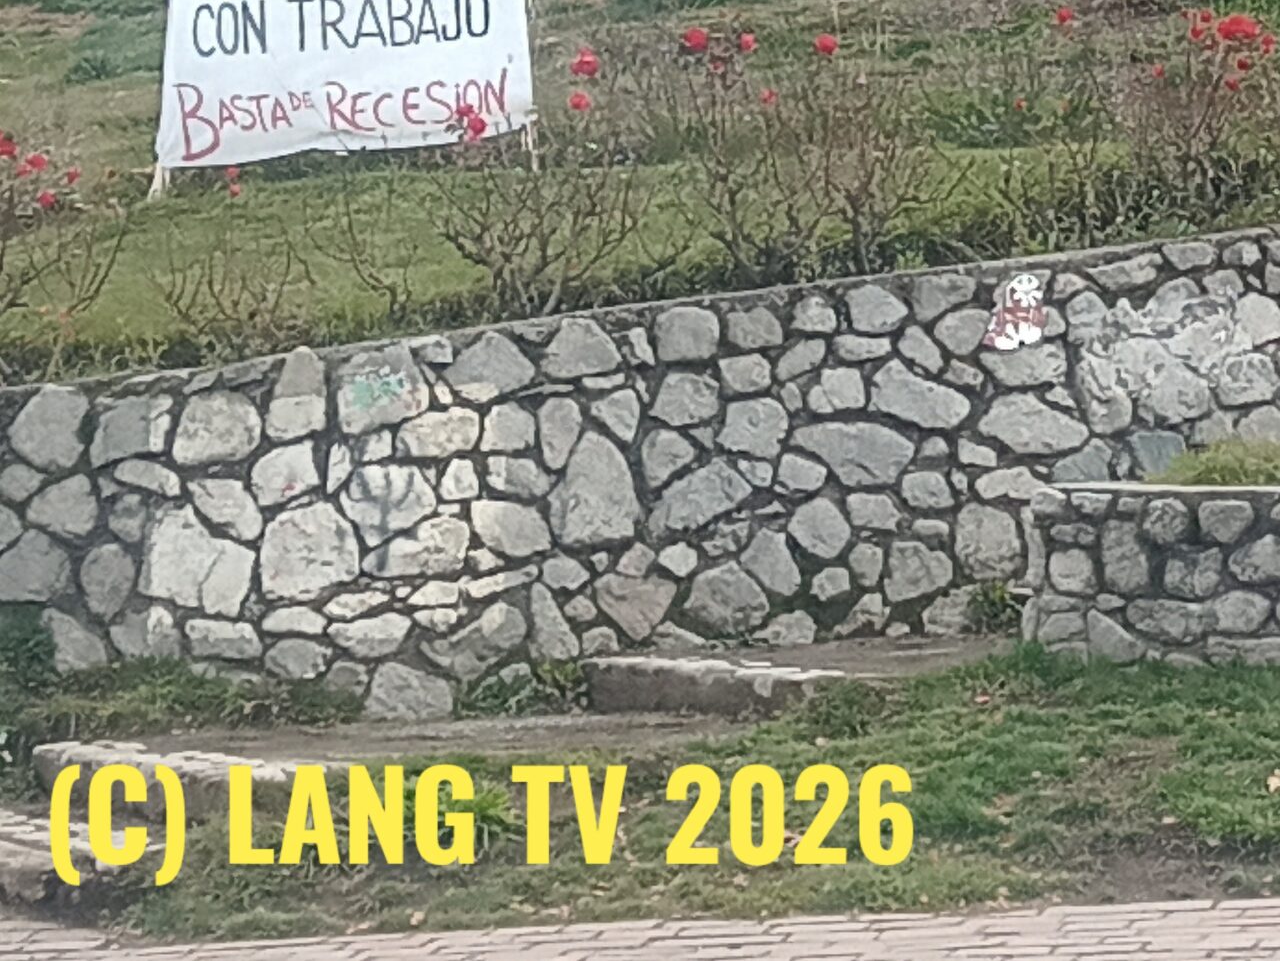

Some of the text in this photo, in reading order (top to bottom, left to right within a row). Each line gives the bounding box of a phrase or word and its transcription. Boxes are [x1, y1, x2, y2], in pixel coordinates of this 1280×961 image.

[192, 0, 268, 58] CON
[172, 82, 293, 162] BASTA
[287, 91, 313, 113] DE
